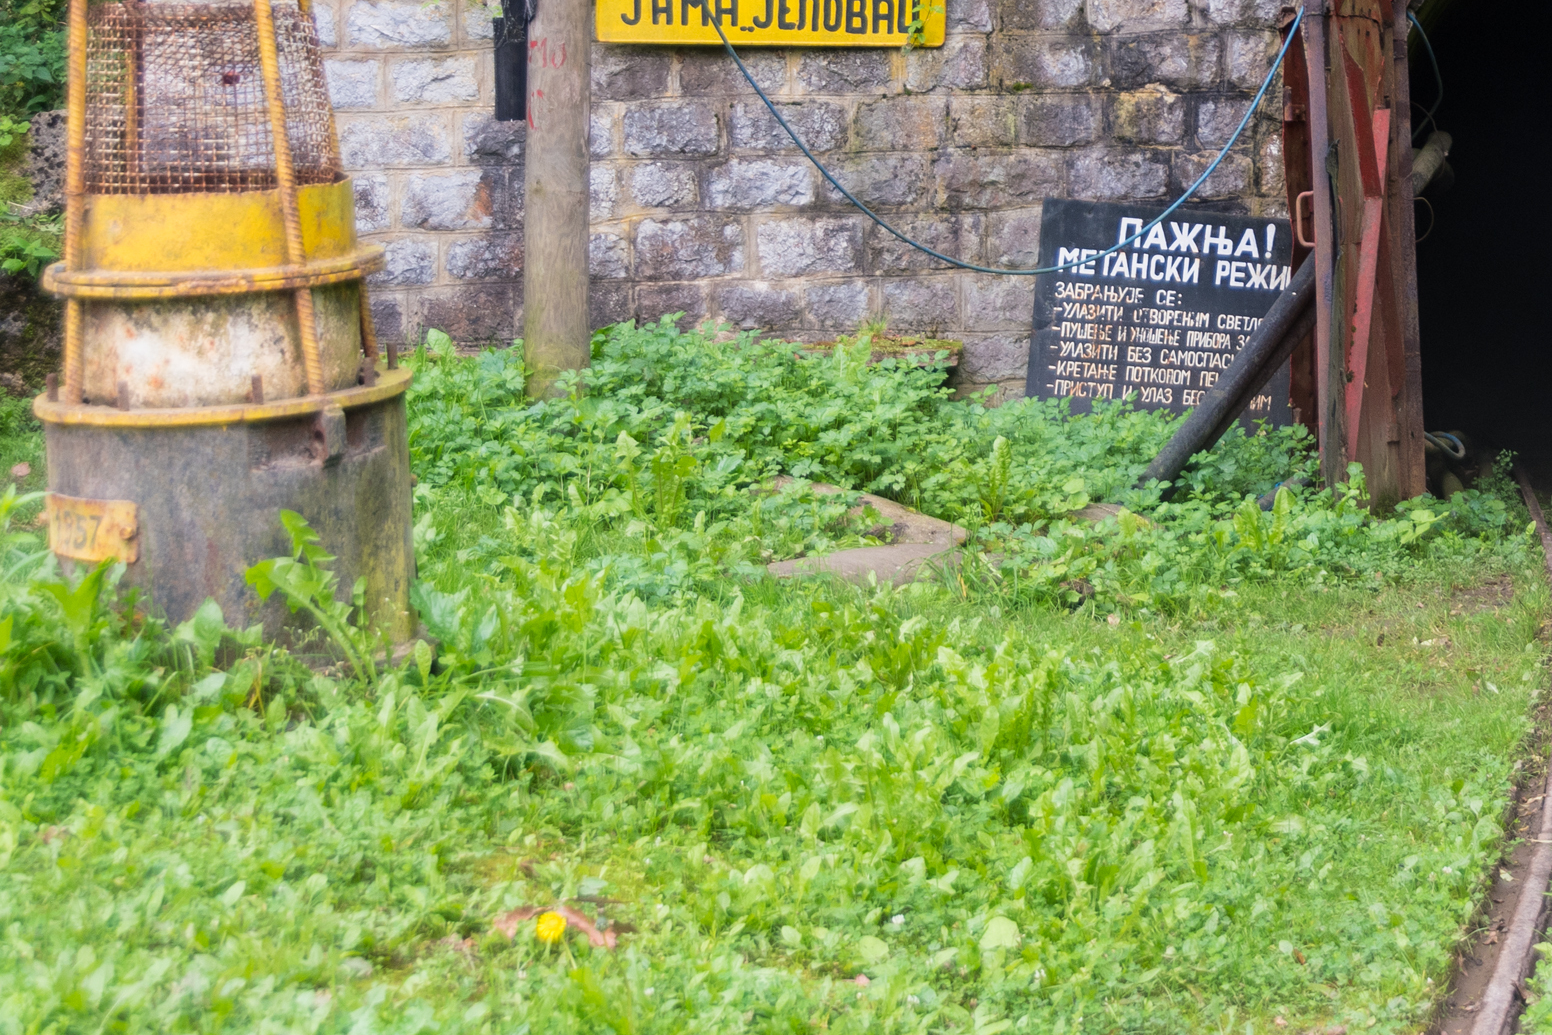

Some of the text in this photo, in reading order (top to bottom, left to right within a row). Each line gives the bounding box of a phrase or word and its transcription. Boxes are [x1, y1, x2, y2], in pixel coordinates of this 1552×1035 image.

[1119, 216, 1276, 259] ПАЖЊА!
[1057, 247, 1200, 284] МЕТАНСКИ
[1054, 281, 1183, 307] ЗАБРАЊУЈЕ СЕ:
[1117, 325, 1128, 342] И
[1186, 330, 1231, 350] ПРИБОРА
[1127, 346, 1152, 364] БЕЗ
[1125, 366, 1191, 386] ПОТКОПОМ
[1140, 386, 1173, 404] УЛАЗ
